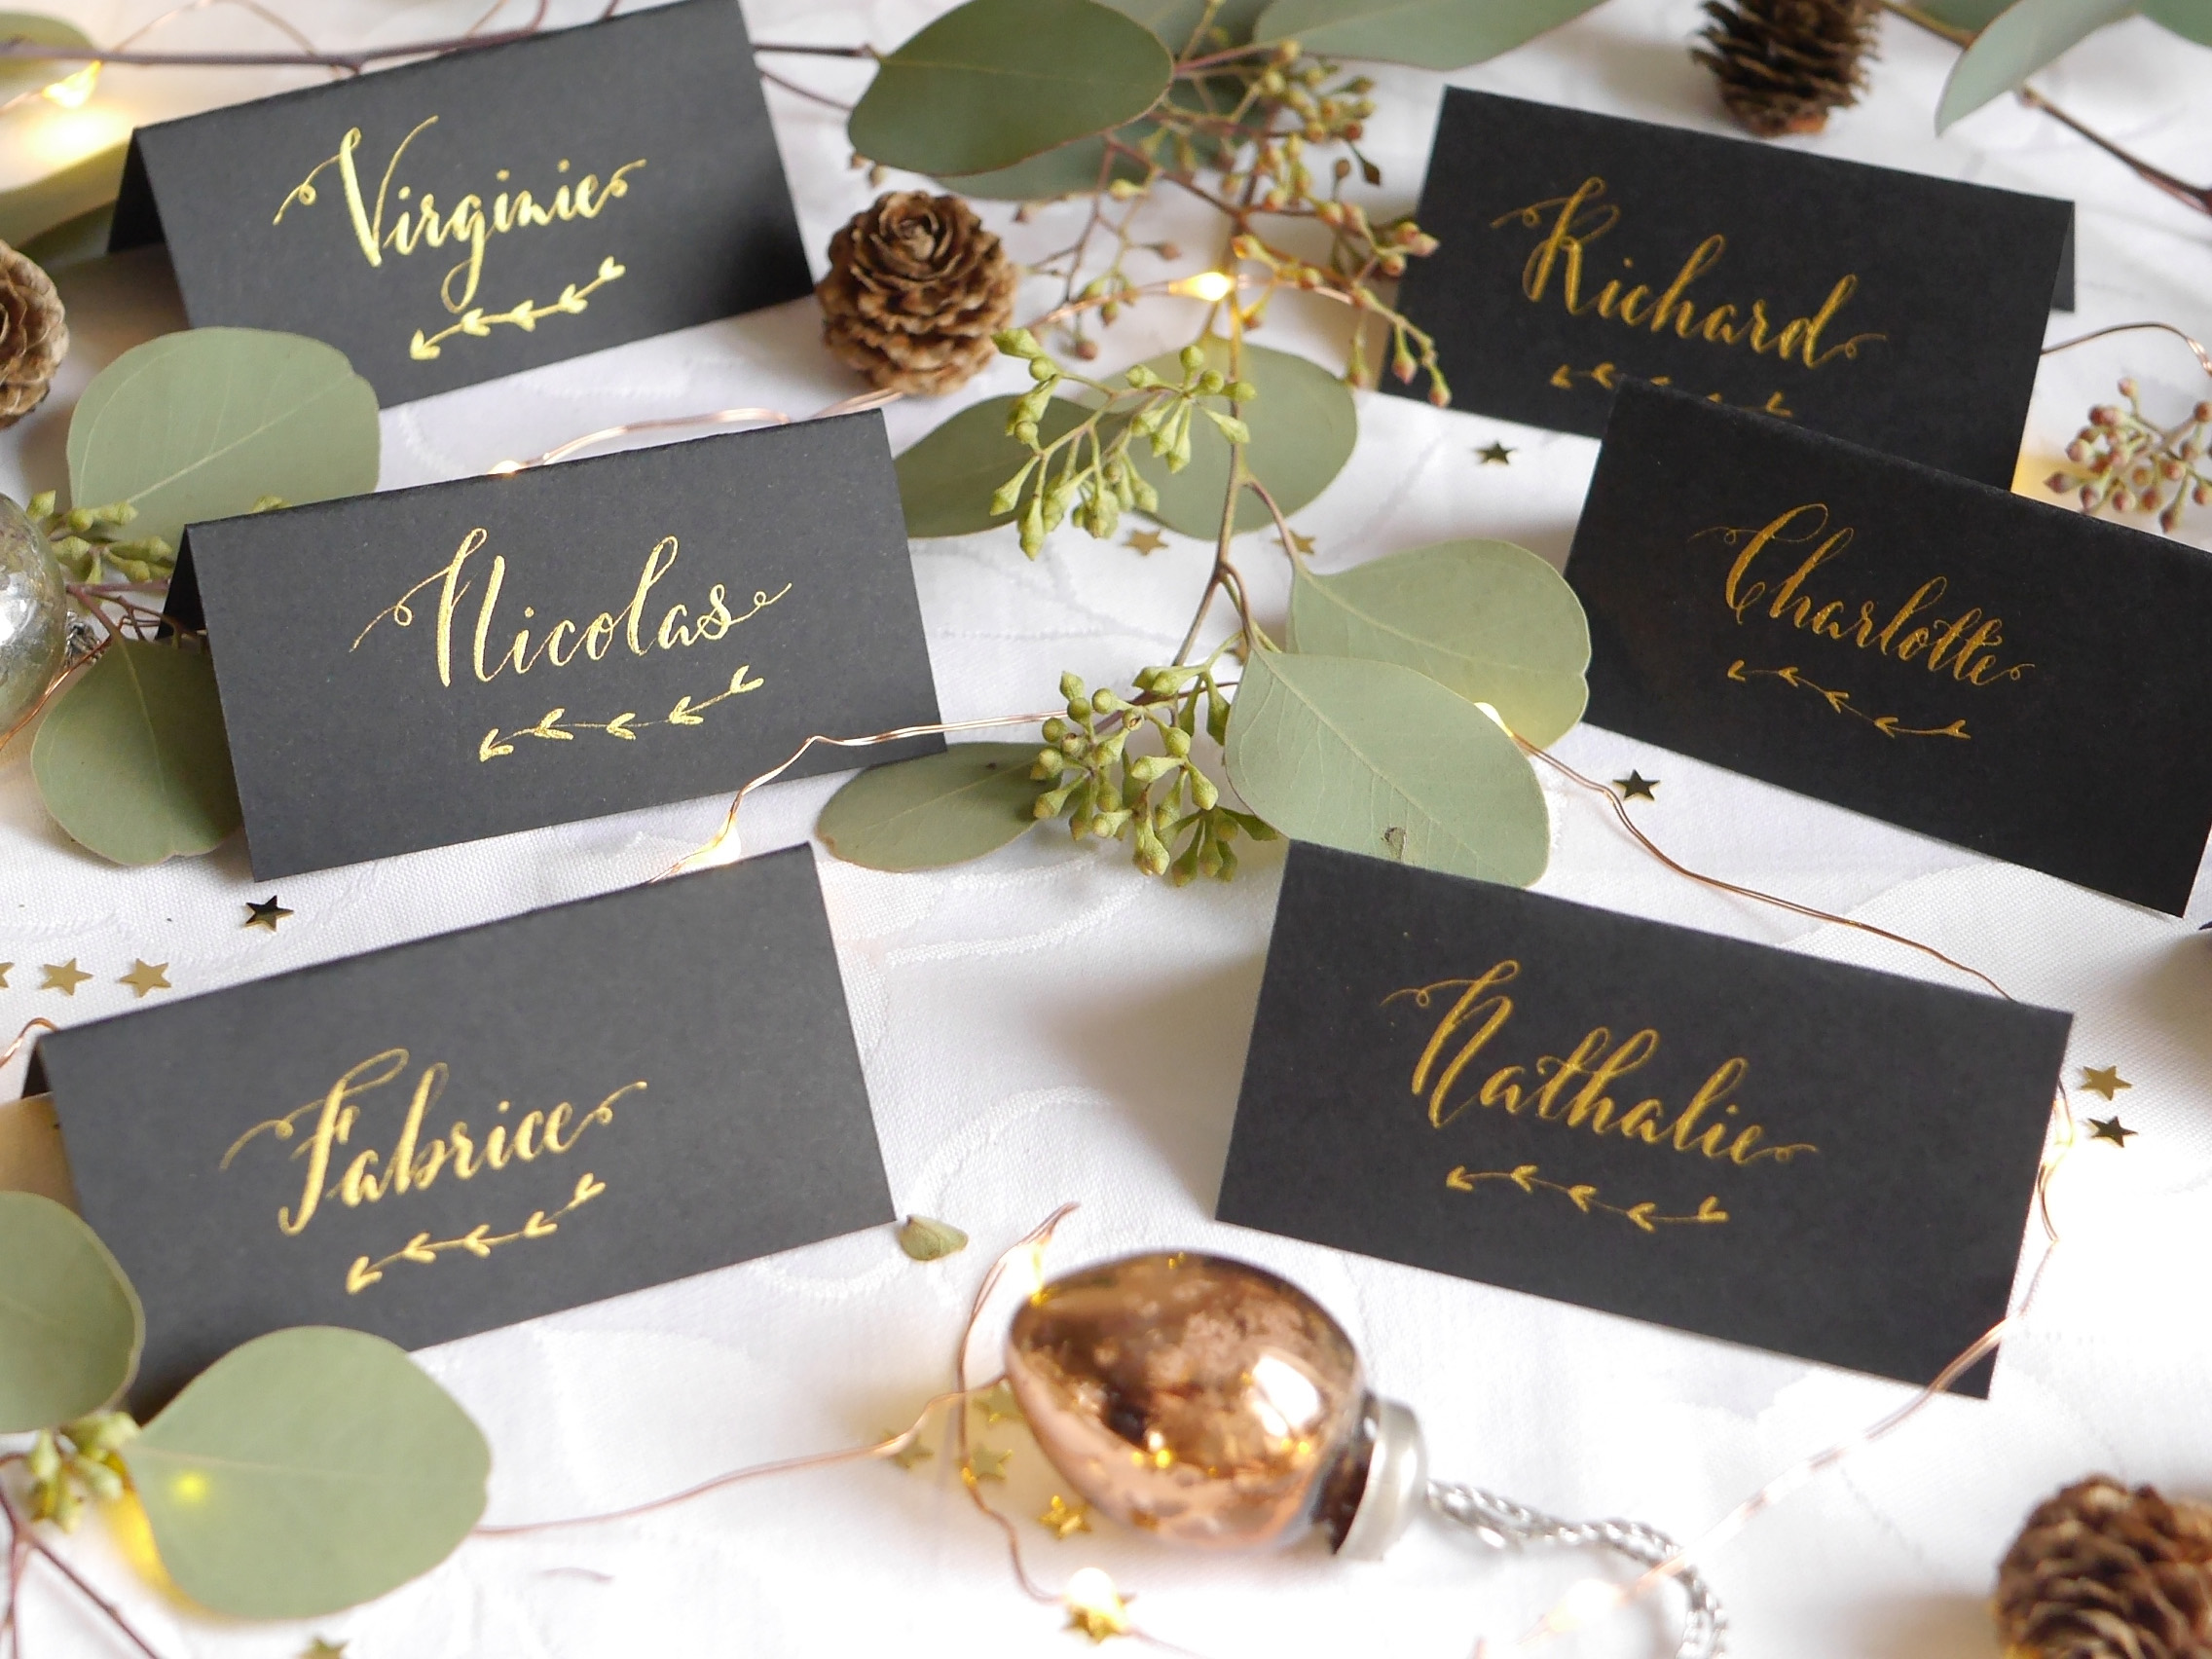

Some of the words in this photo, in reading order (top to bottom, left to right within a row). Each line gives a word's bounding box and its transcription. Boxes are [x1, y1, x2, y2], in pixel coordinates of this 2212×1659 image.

[273, 115, 647, 313] Virginie
[1491, 176, 1888, 370] Richard
[350, 527, 793, 687] Nicolas
[1688, 502, 2037, 687] Charlotte
[220, 1047, 648, 1237] Fabrice
[1381, 959, 1819, 1164] Nathalie
